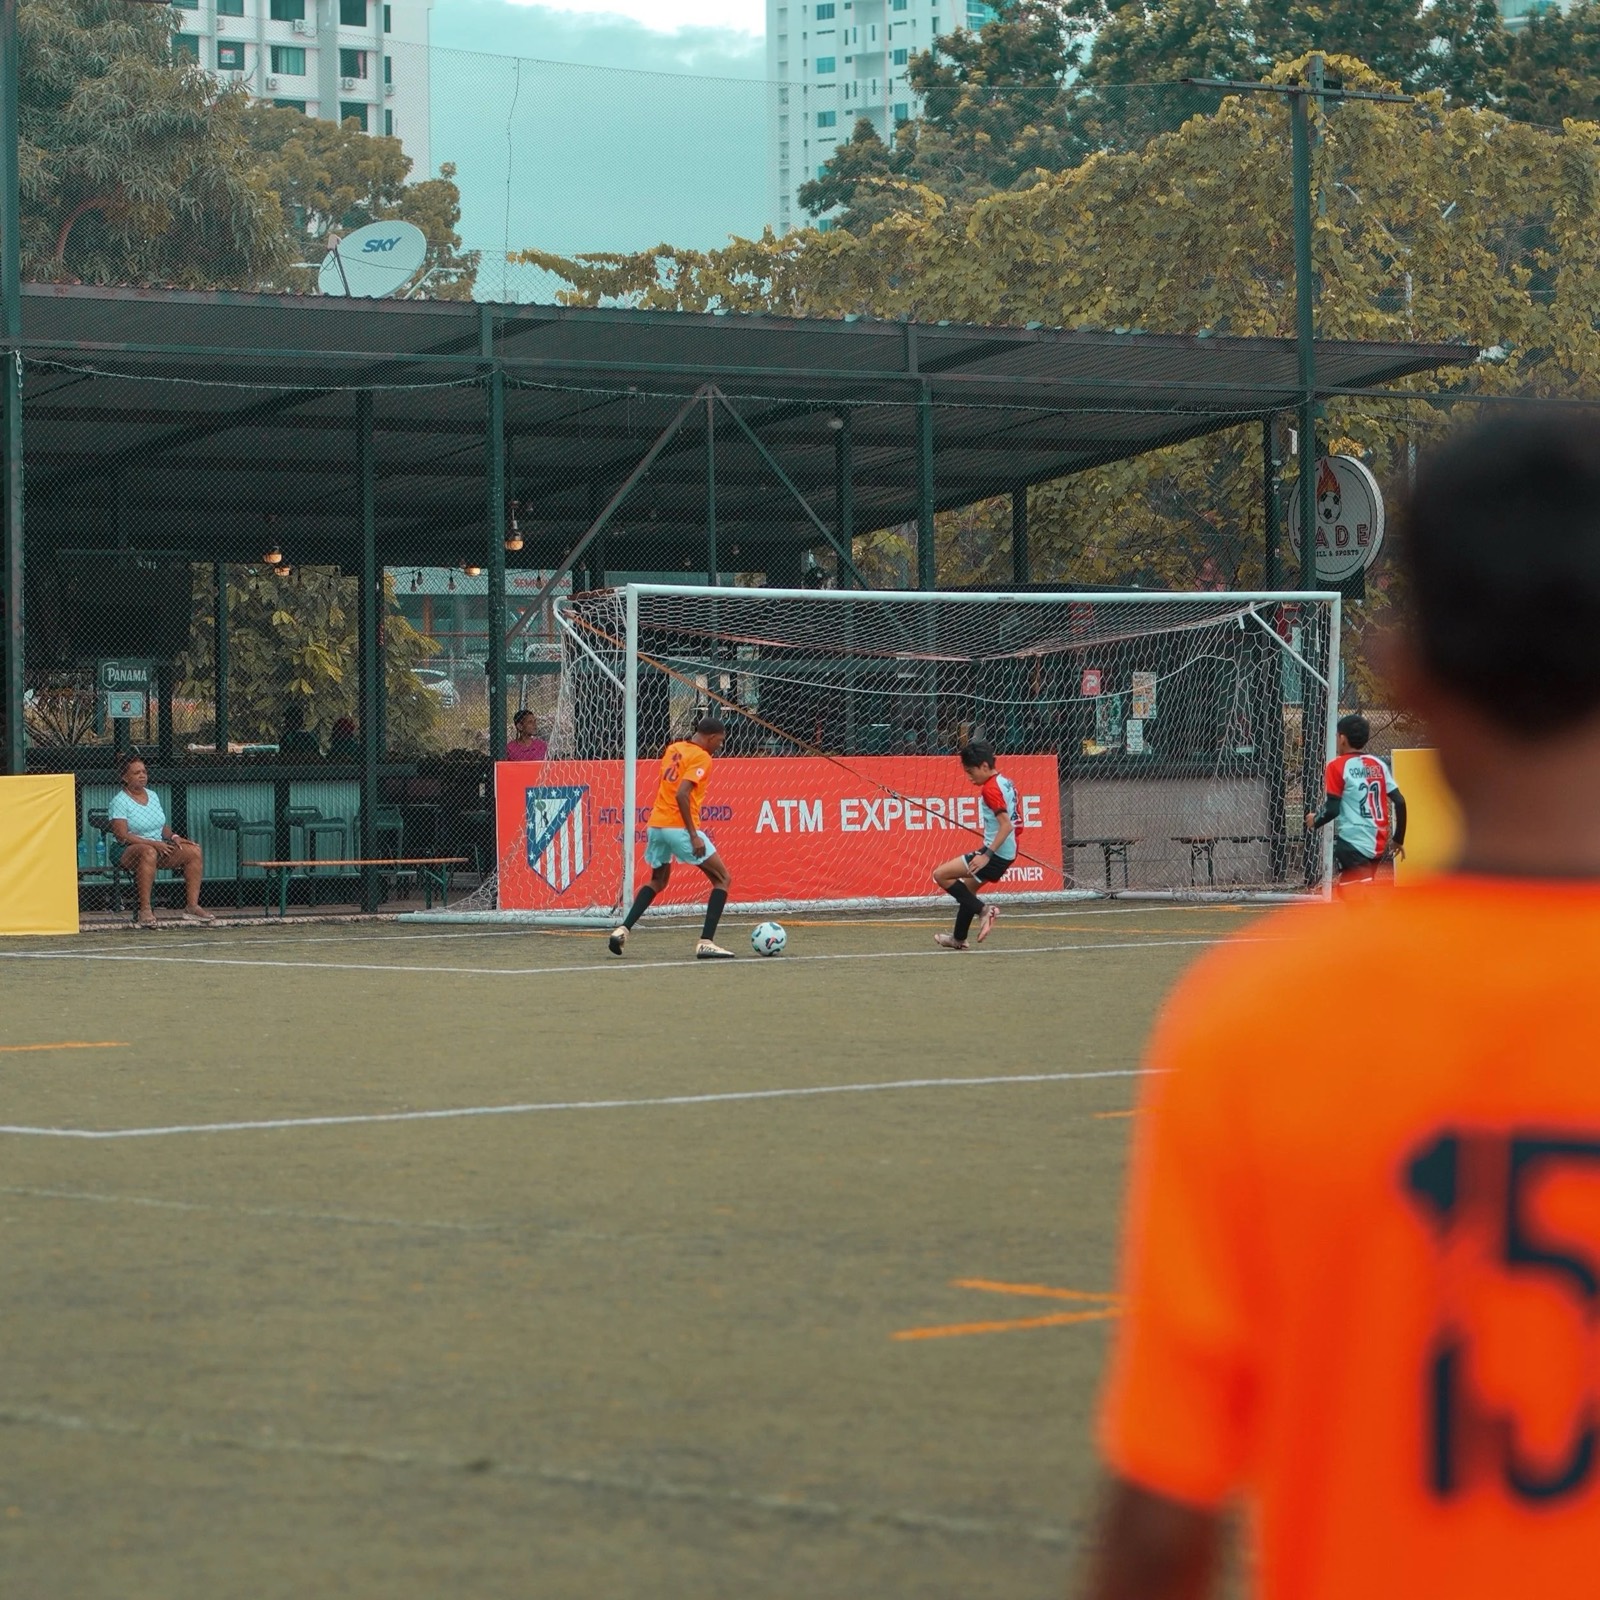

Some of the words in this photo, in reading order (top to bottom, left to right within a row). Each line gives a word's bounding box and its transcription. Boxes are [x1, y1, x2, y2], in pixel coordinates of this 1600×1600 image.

[362, 237, 402, 252] SKY
[1335, 549, 1359, 557] SPORTS
[106, 667, 147, 681] PANAMÁ
[1358, 781, 1382, 820] 21
[701, 806, 732, 821] DRID
[755, 799, 823, 833] ATM
[840, 795, 1043, 832] EXPERIEE
[1000, 866, 1043, 881] RTNER
[1404, 1130, 1600, 1506] 15
